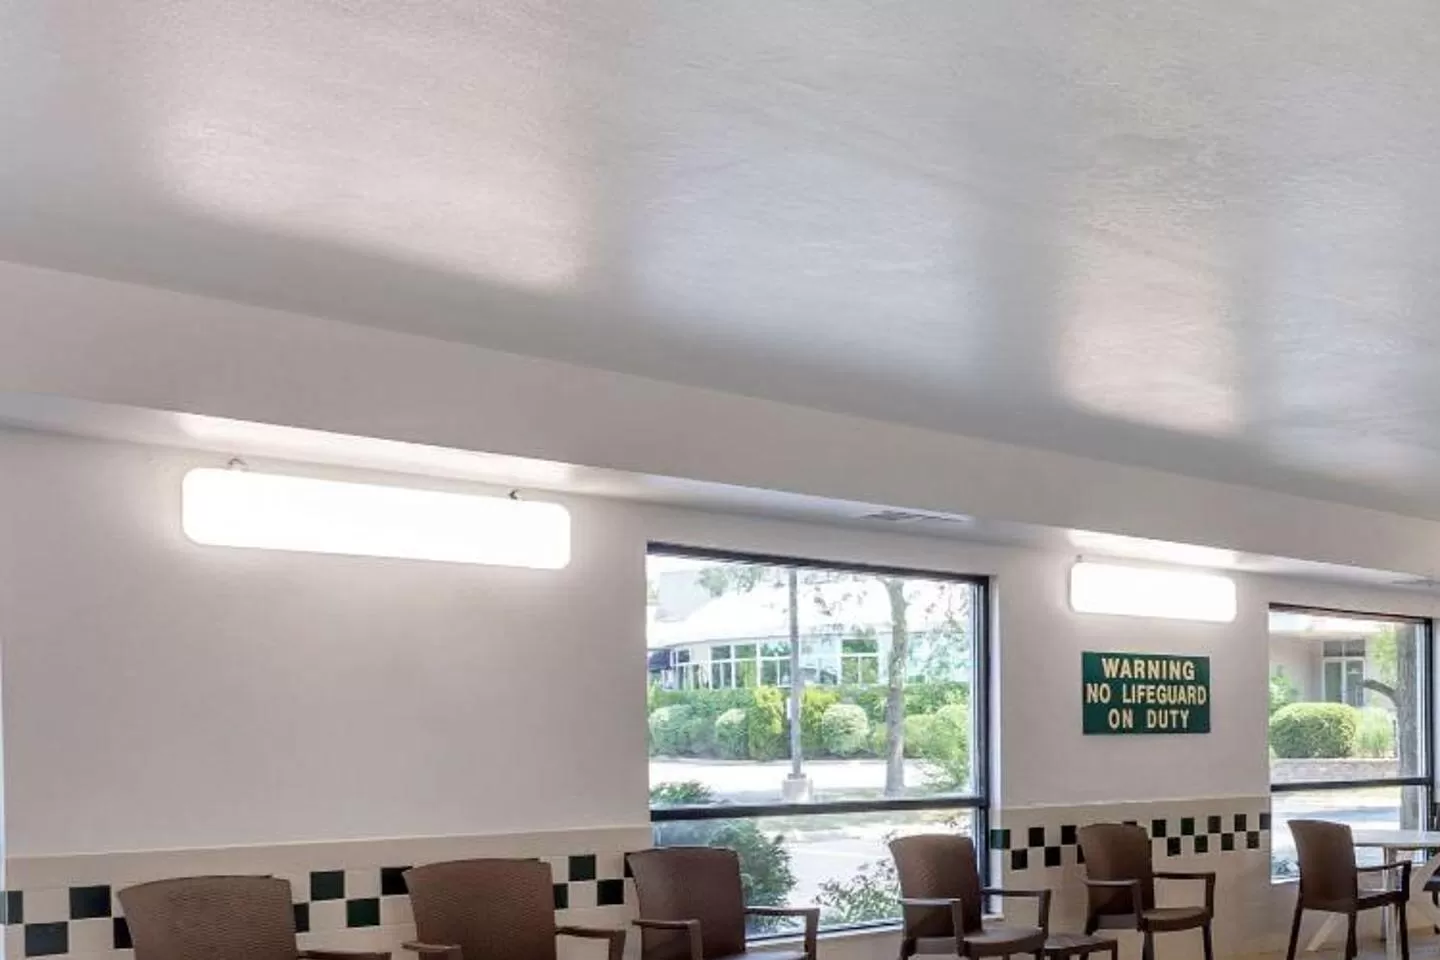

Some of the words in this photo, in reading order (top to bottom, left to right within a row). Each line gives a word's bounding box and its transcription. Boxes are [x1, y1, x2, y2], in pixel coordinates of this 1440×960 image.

[1102, 657, 1196, 681] WARNING
[1086, 683, 1111, 704] NO
[1122, 683, 1207, 705] LIFEGUARD
[1108, 708, 1133, 729] ON
[1147, 709, 1190, 729] DUTY
